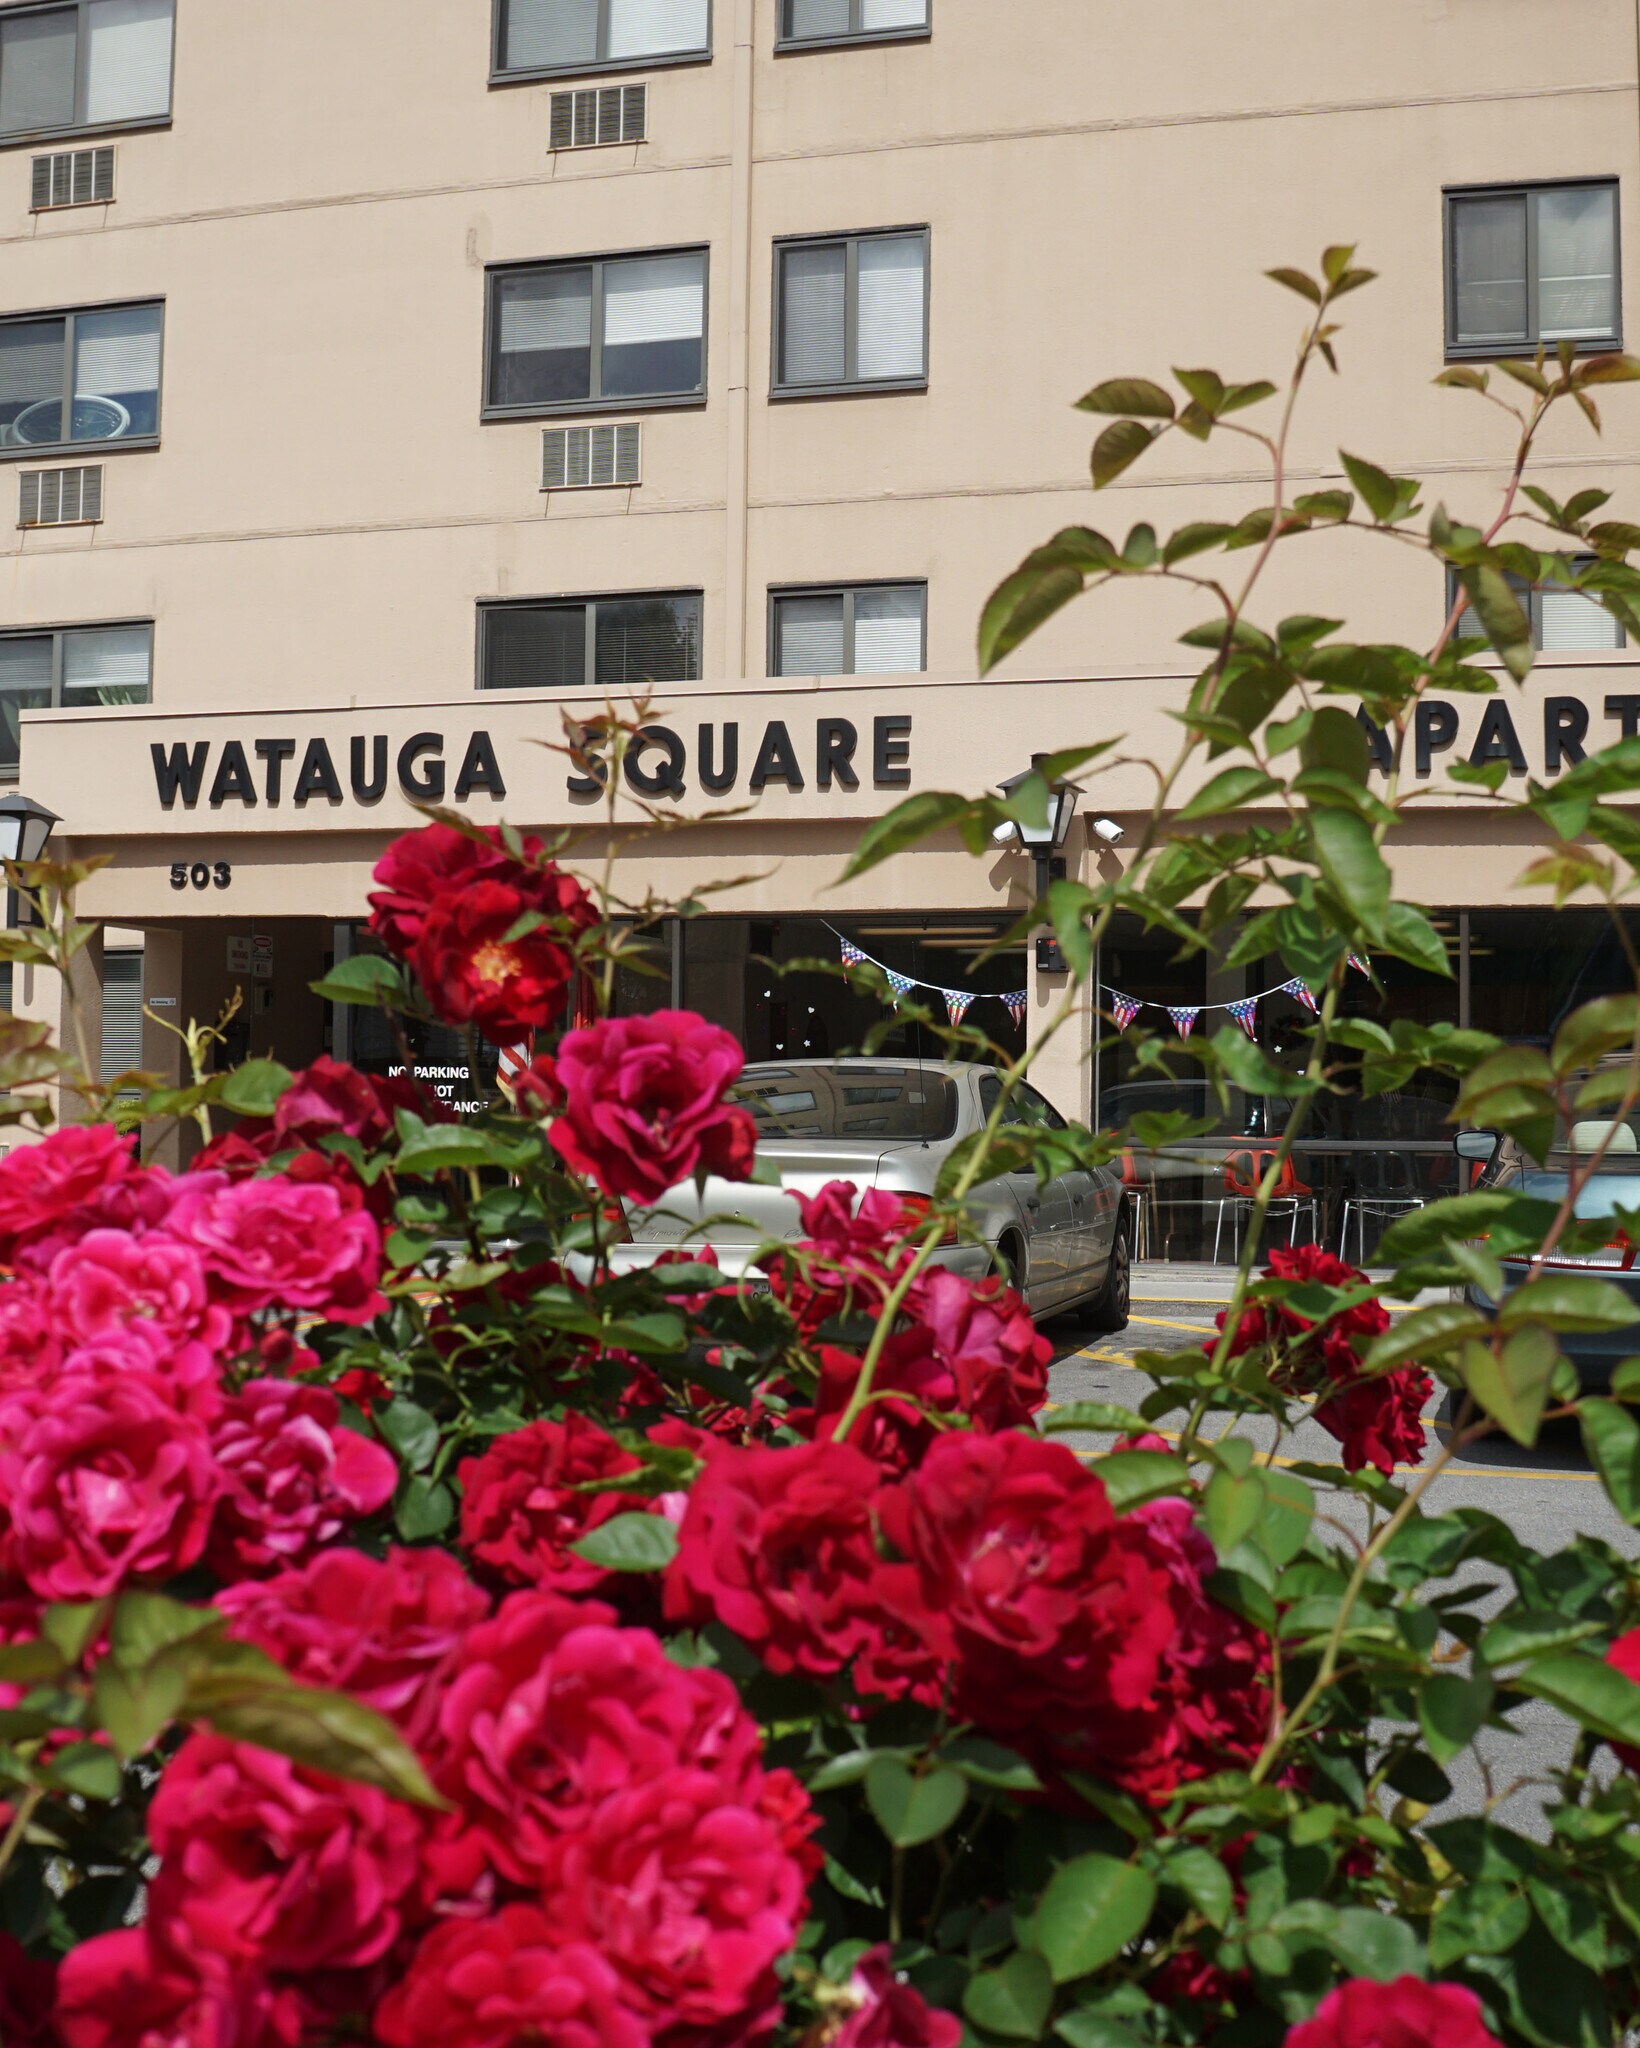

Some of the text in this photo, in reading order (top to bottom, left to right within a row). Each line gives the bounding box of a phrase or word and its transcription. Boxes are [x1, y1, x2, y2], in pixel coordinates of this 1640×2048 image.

[150, 730, 507, 806] WATAUGA
[566, 715, 912, 796] SQUARE
[170, 861, 232, 890] 503
[414, 1066, 469, 1079] PARKING
